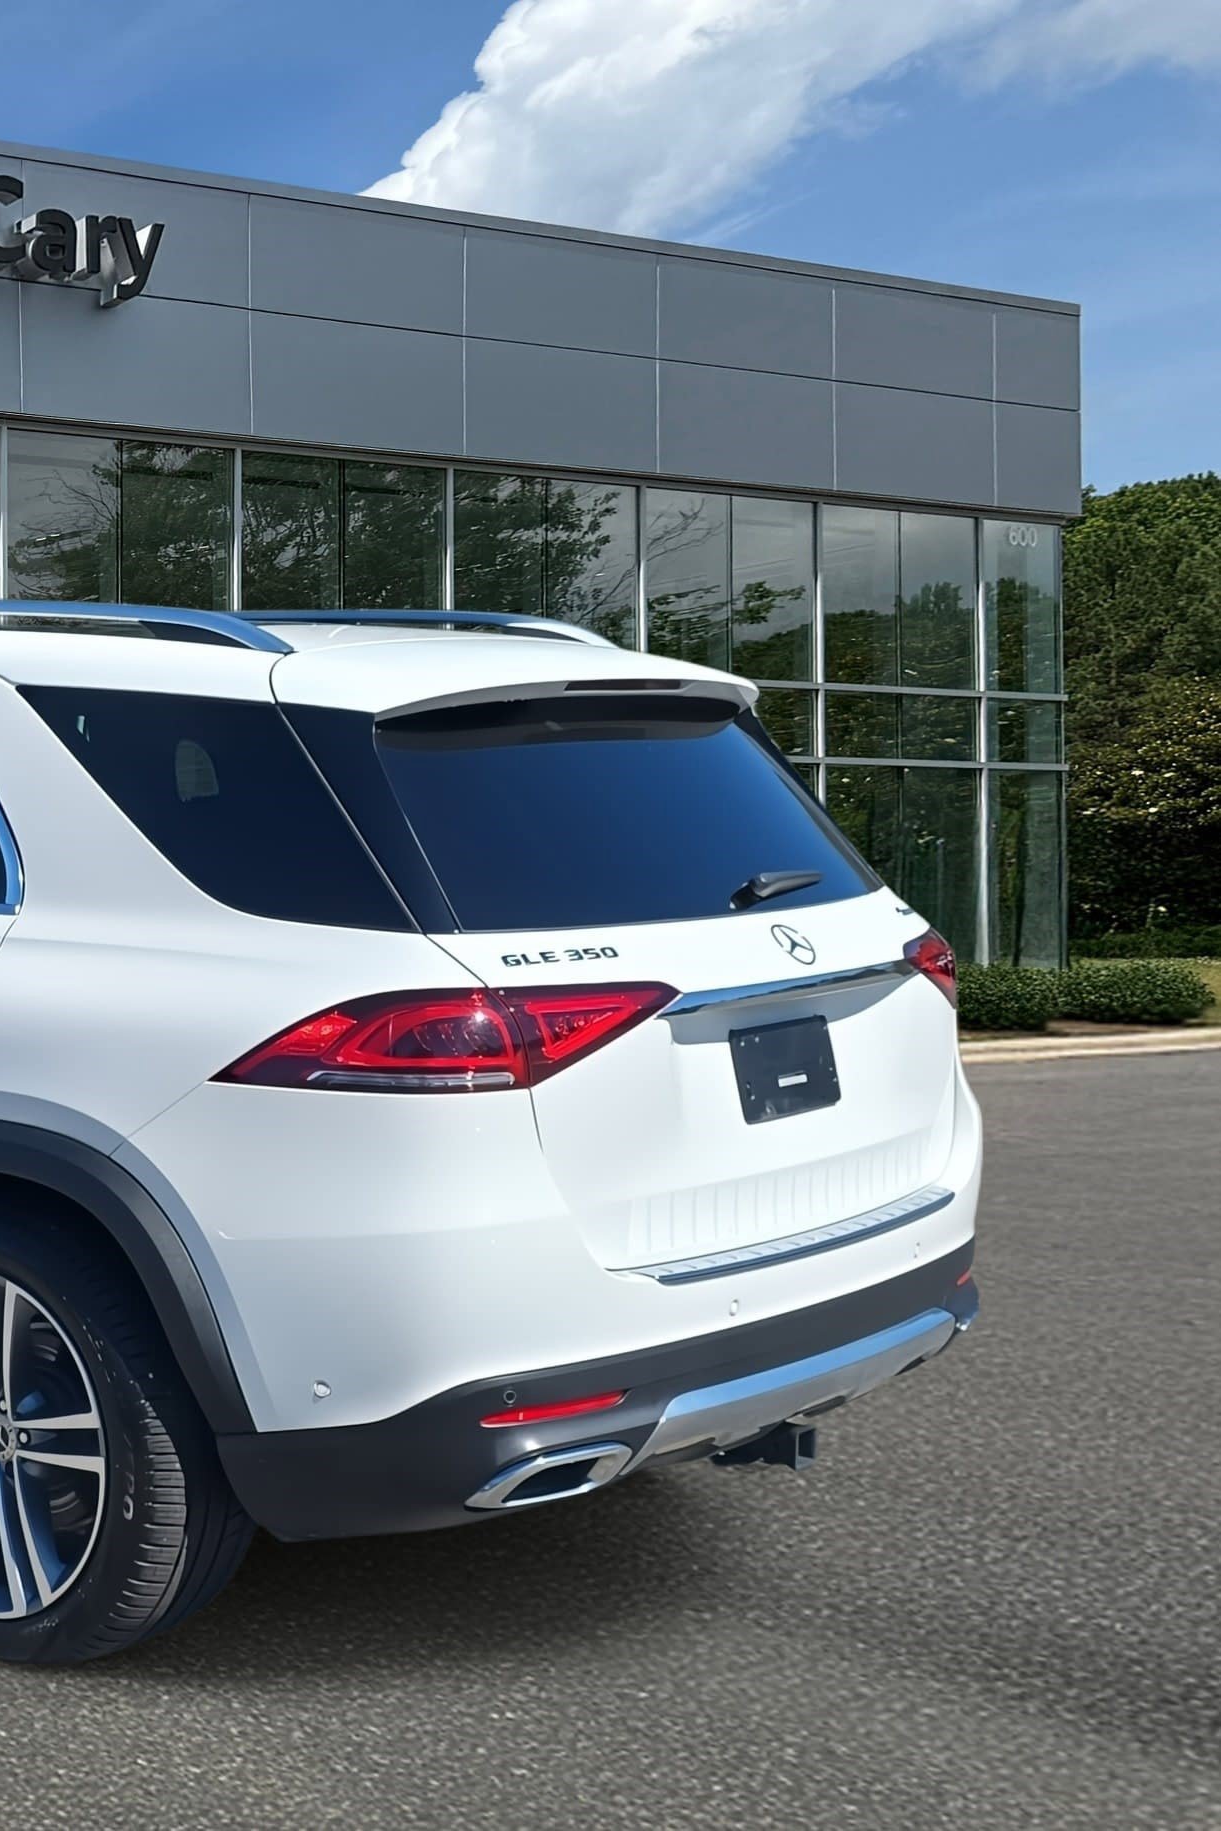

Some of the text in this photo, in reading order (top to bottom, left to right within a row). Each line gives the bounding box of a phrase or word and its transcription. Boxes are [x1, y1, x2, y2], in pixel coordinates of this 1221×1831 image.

[1009, 526, 1038, 547] 600
[500, 946, 619, 967] GLE 350
